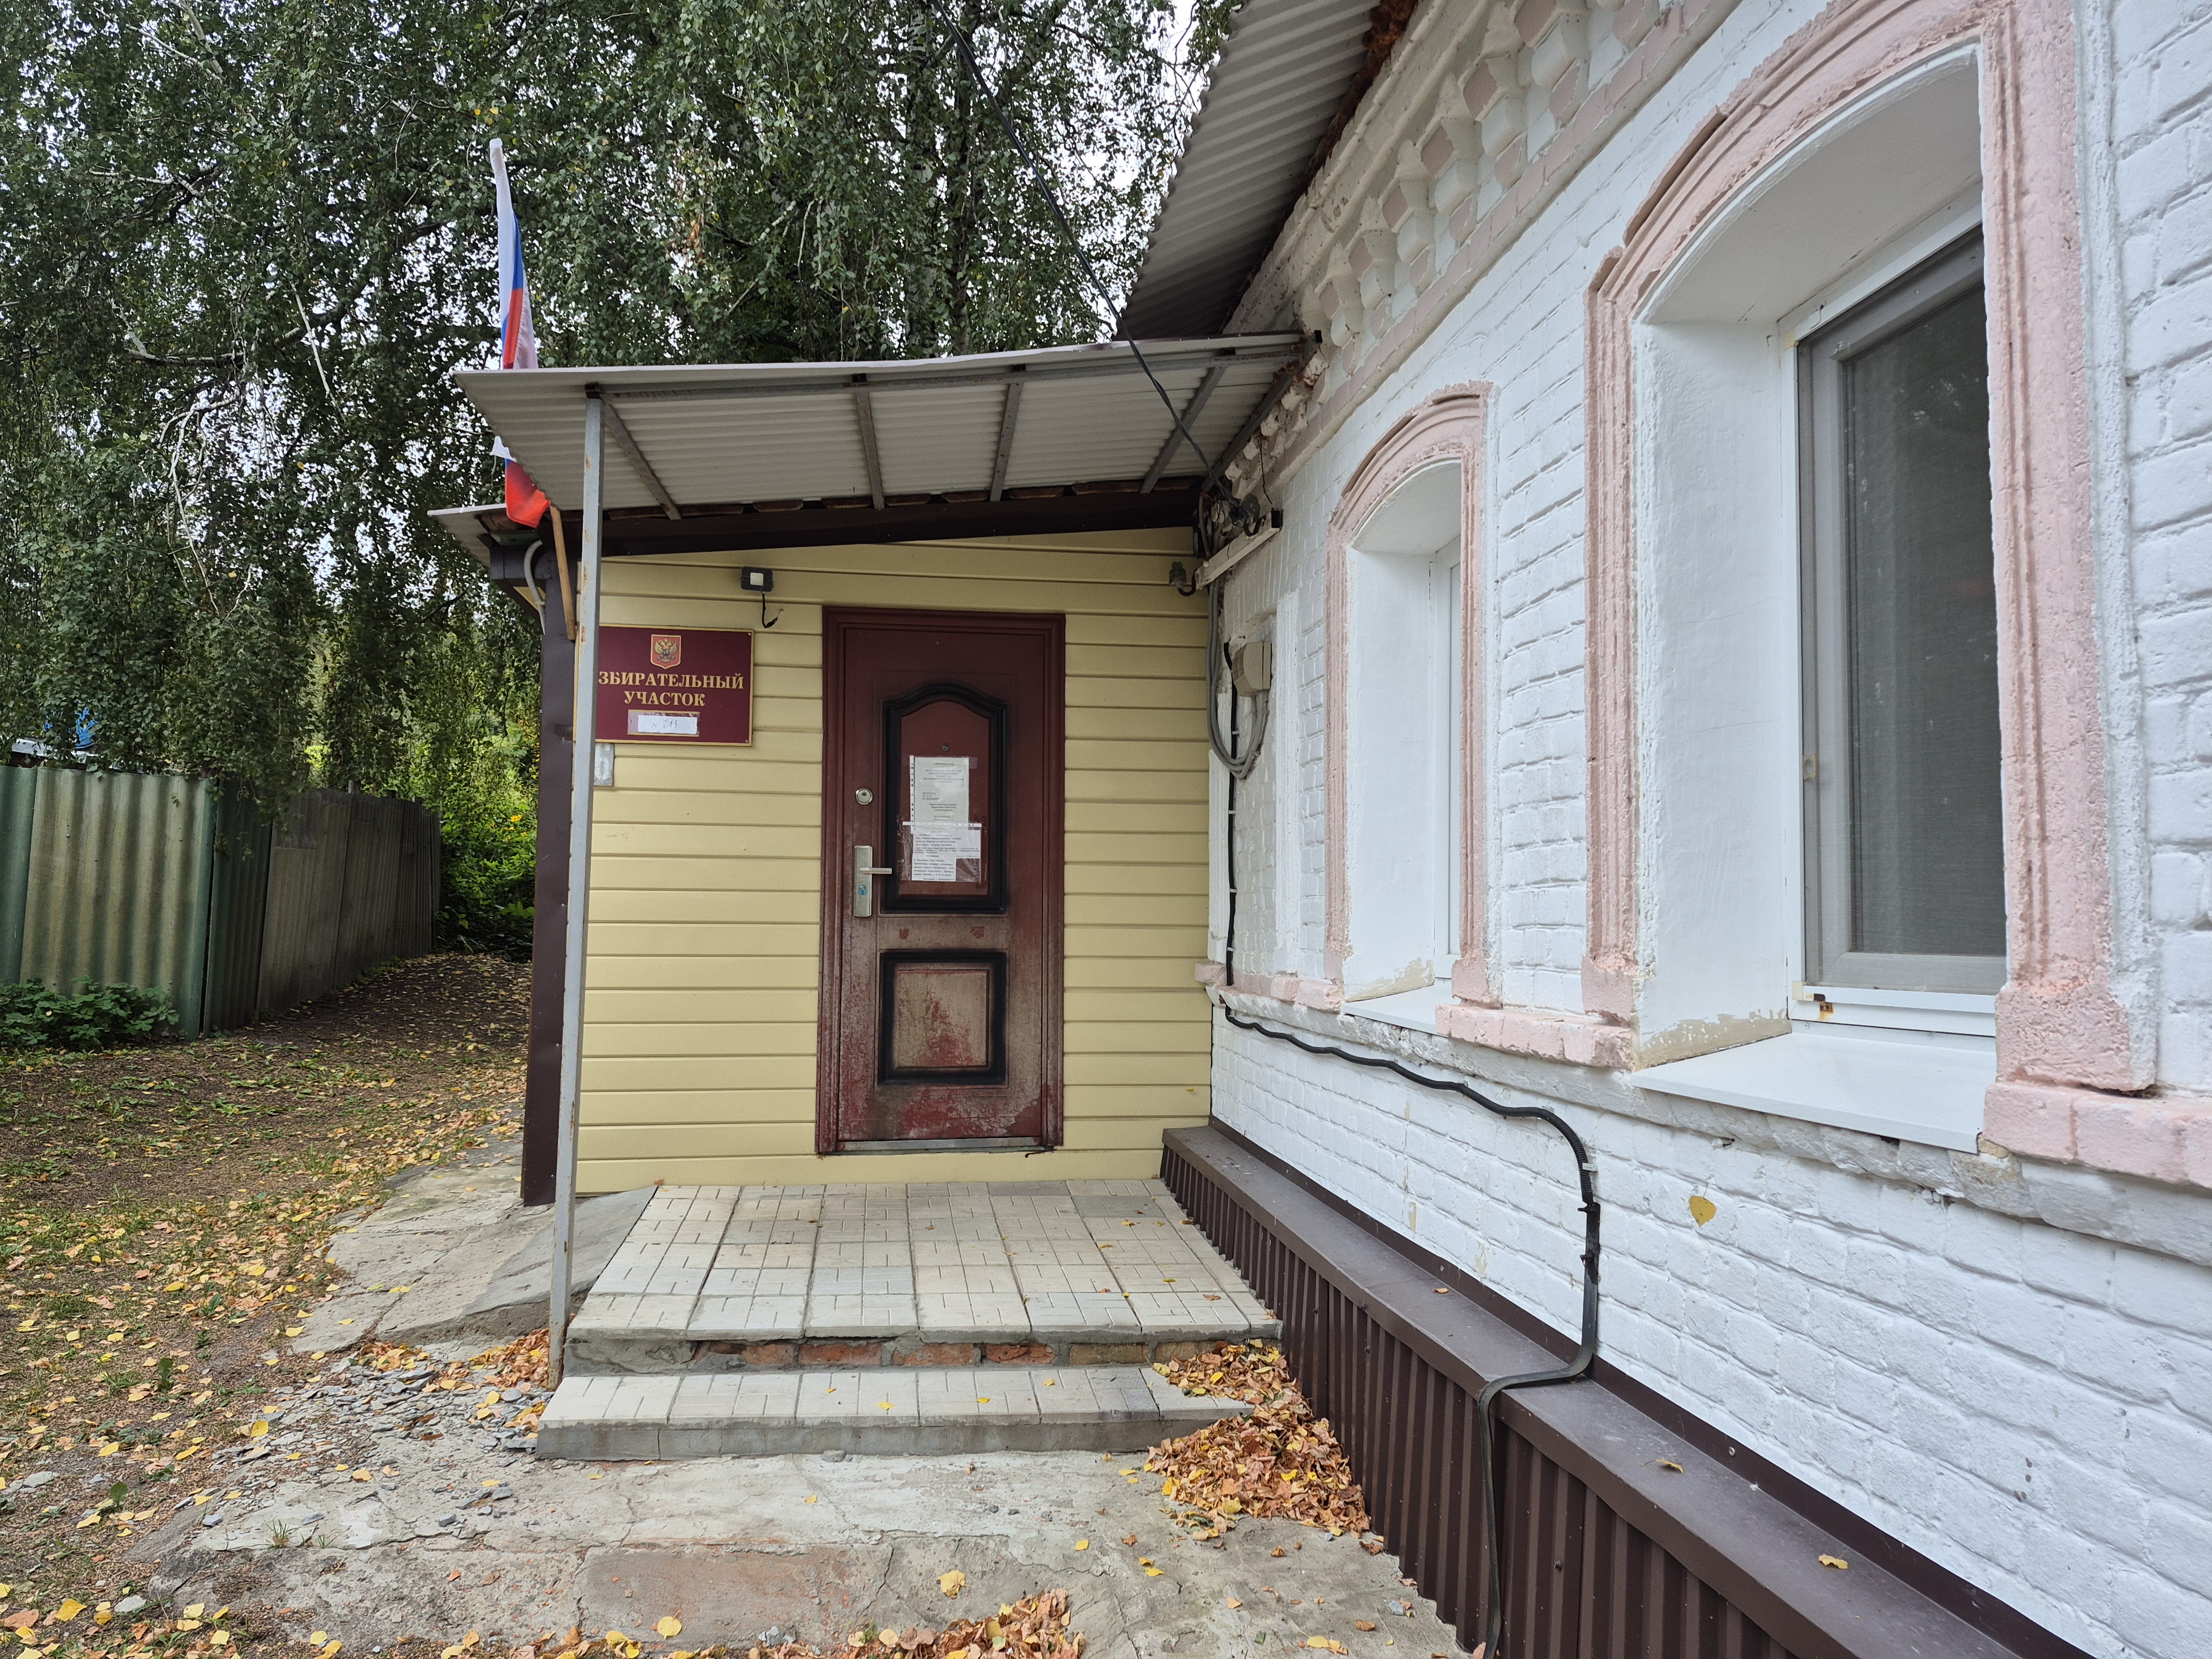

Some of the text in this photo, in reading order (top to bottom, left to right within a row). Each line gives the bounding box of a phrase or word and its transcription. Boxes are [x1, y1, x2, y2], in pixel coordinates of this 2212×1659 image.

[598, 671, 744, 690] ЗБИРАТЕЛЬНЫЙ
[623, 691, 706, 707] УЧАСТОК
[663, 719, 678, 729] 213
